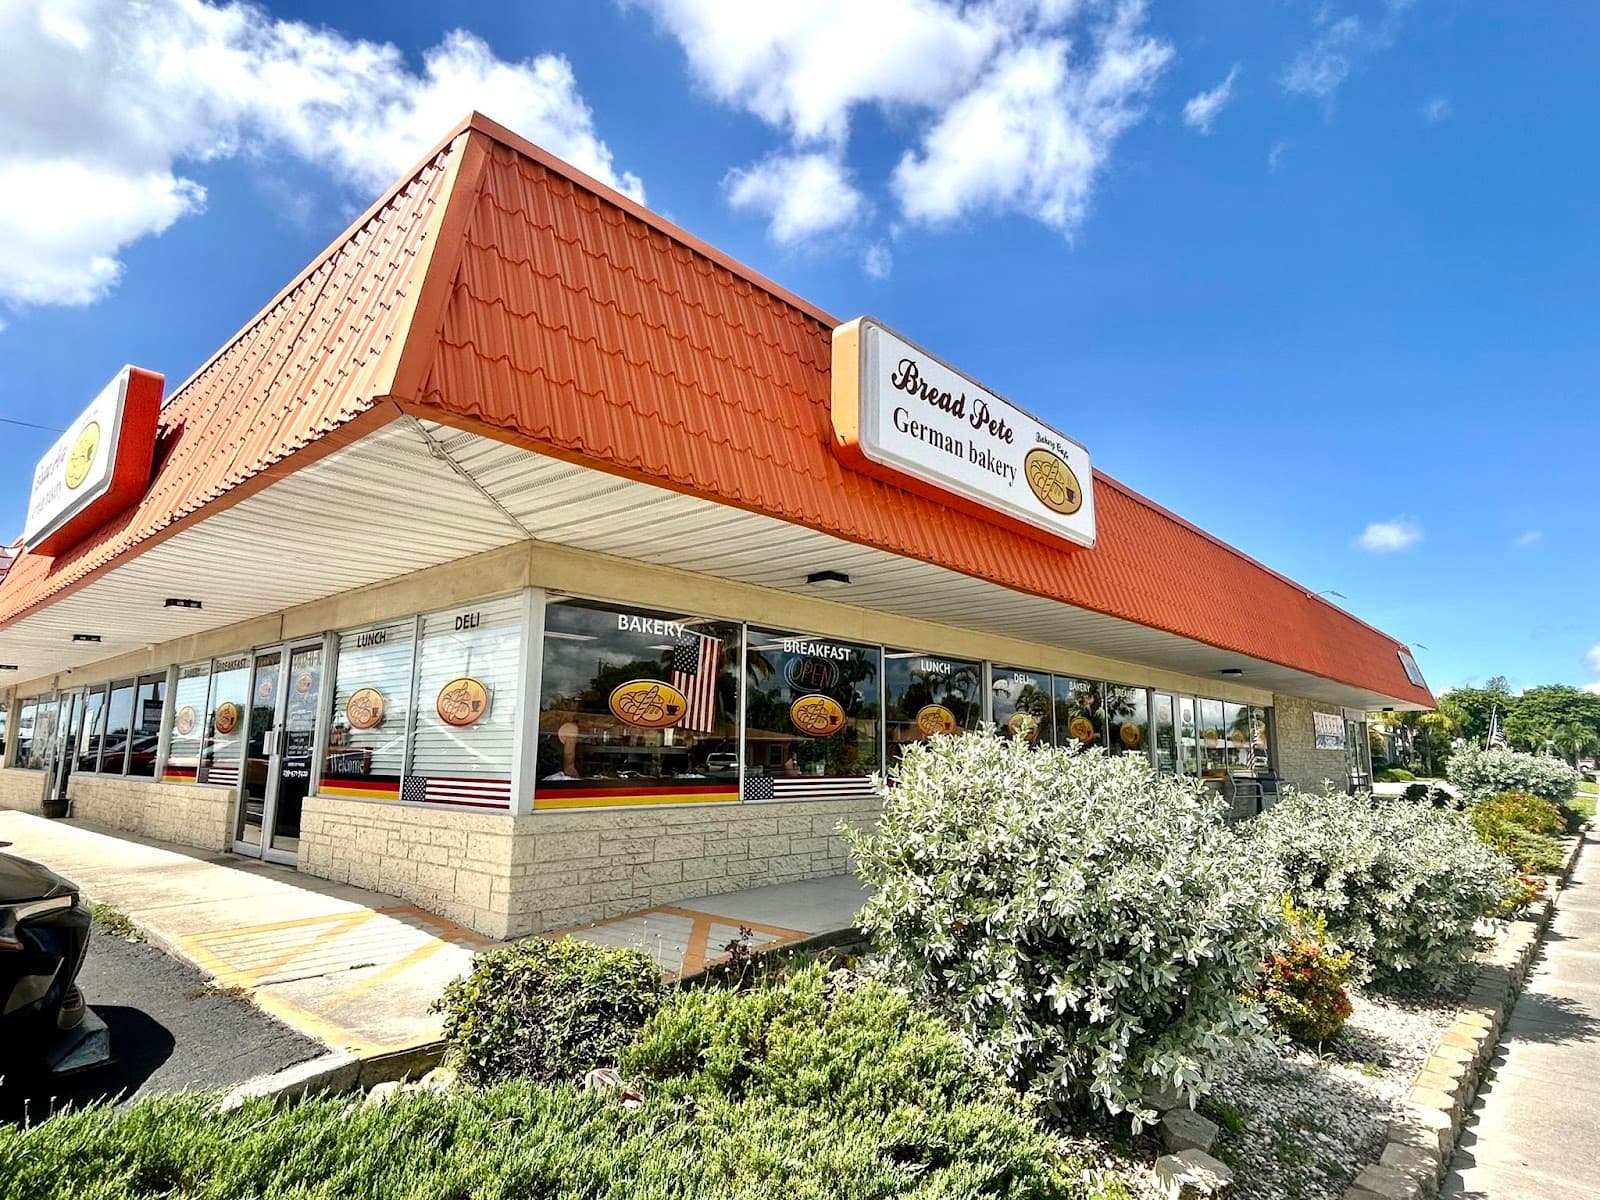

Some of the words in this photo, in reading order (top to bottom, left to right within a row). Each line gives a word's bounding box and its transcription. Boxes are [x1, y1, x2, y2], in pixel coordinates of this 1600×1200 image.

[891, 358, 965, 419] Bread
[969, 398, 1014, 445] Pete
[893, 406, 963, 458] German
[969, 441, 1017, 487] bakery
[455, 612, 480, 631] DELI
[617, 614, 685, 638] BAKERY
[356, 630, 387, 648] LUNCH
[783, 639, 851, 661] BREAKFAST
[790, 656, 832, 689] OPEN
[920, 658, 951, 675] LUNCH
[1013, 672, 1030, 685] DELI
[329, 753, 365, 774] Welcome
